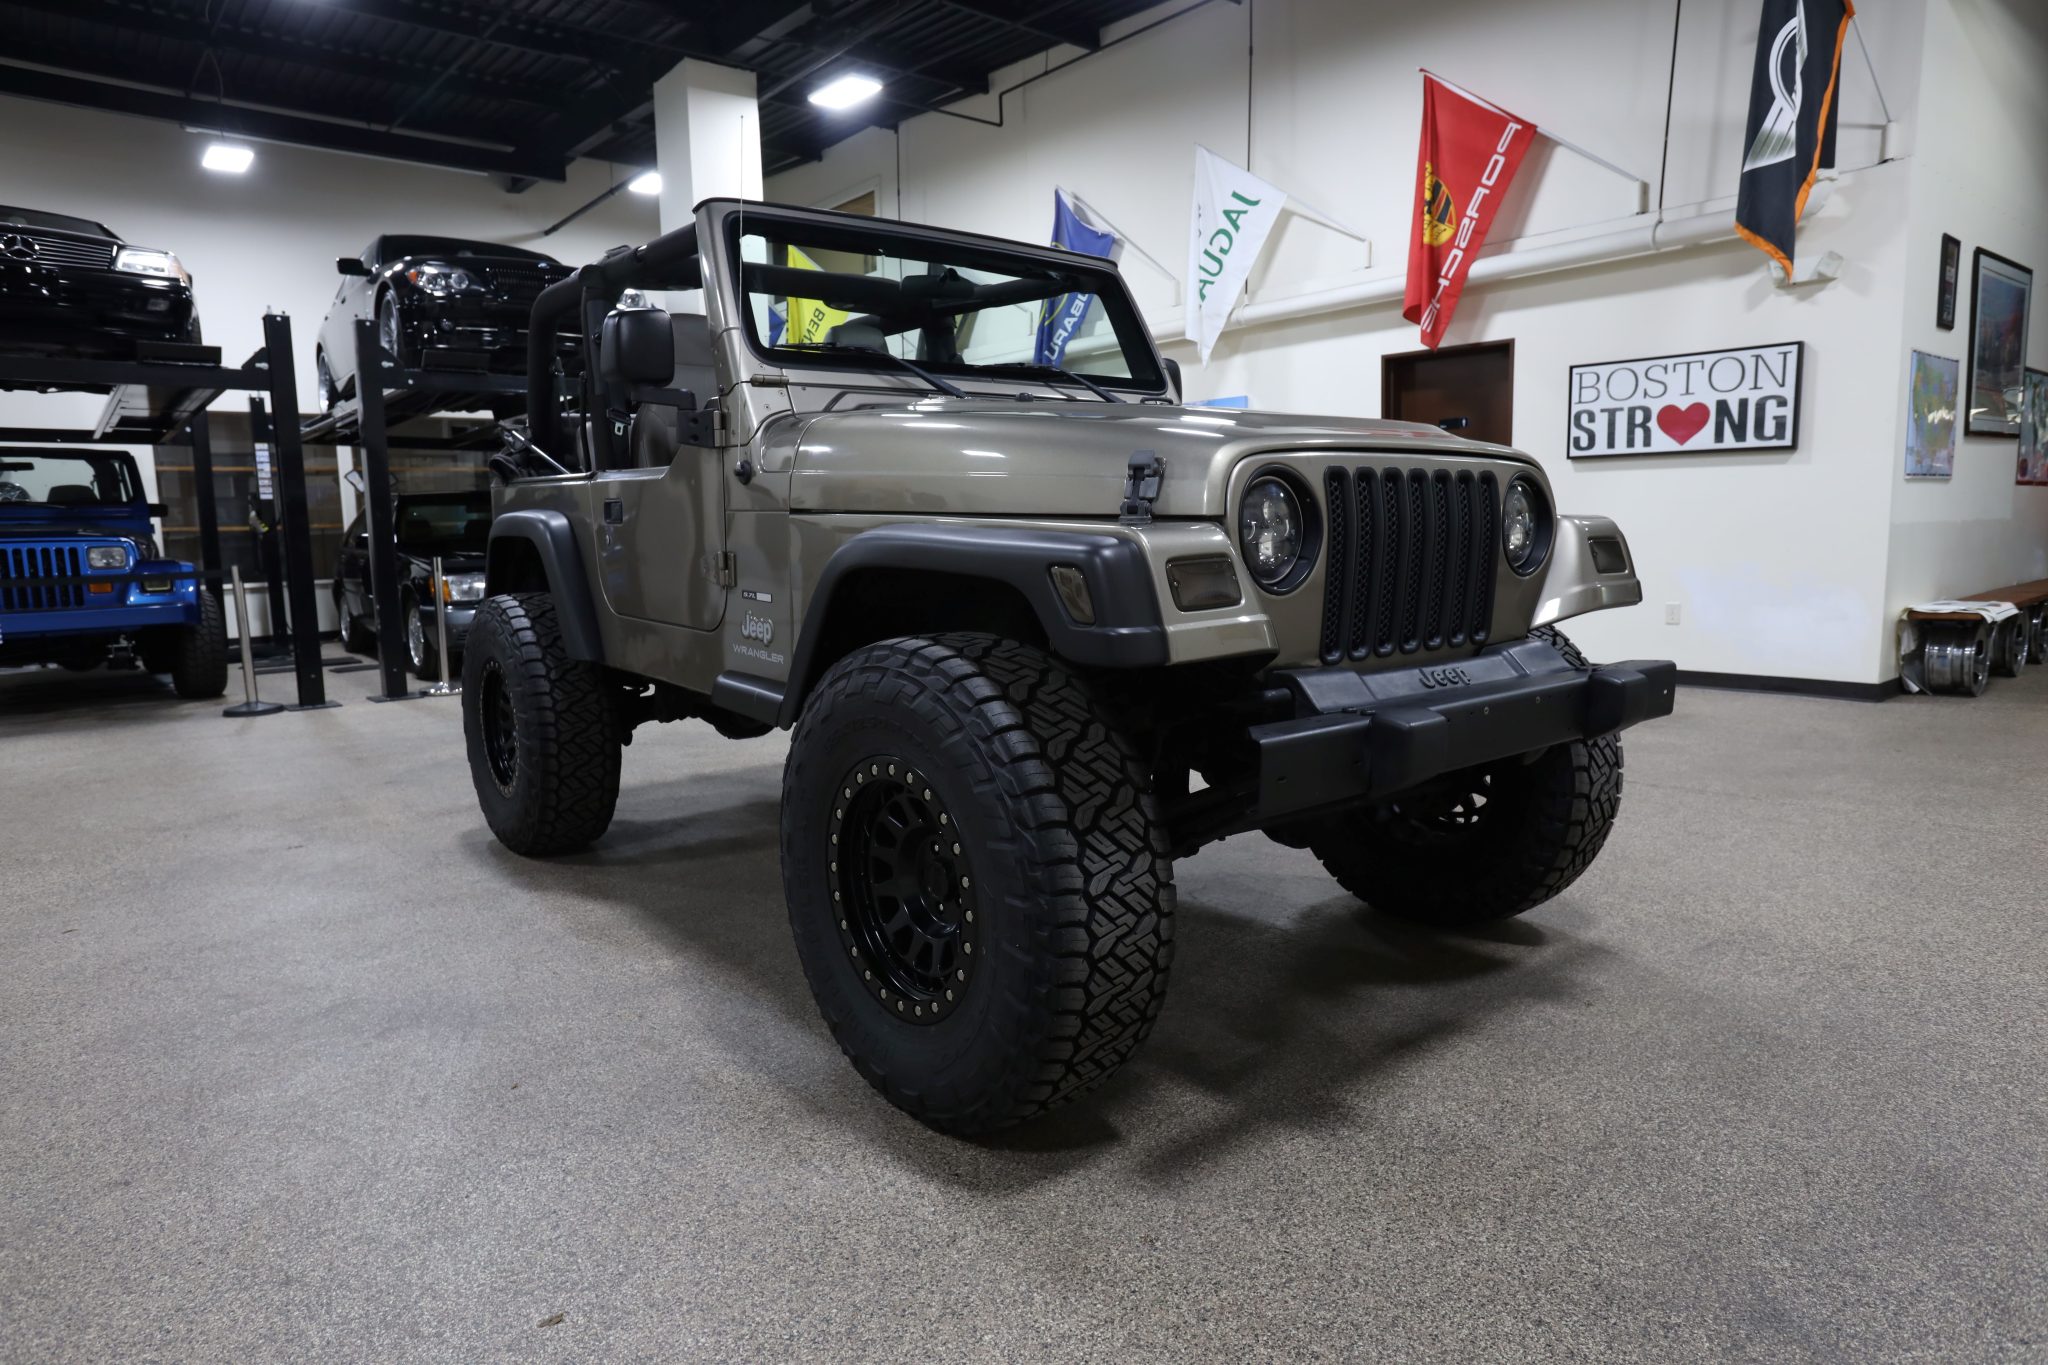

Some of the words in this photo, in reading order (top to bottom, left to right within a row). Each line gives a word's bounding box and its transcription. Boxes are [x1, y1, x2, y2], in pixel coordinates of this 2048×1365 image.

[1573, 350, 1793, 405] BOSTON
[741, 610, 775, 646] Jeep
[732, 643, 784, 665] WRANGLER
[1418, 667, 1472, 690] Jeep
